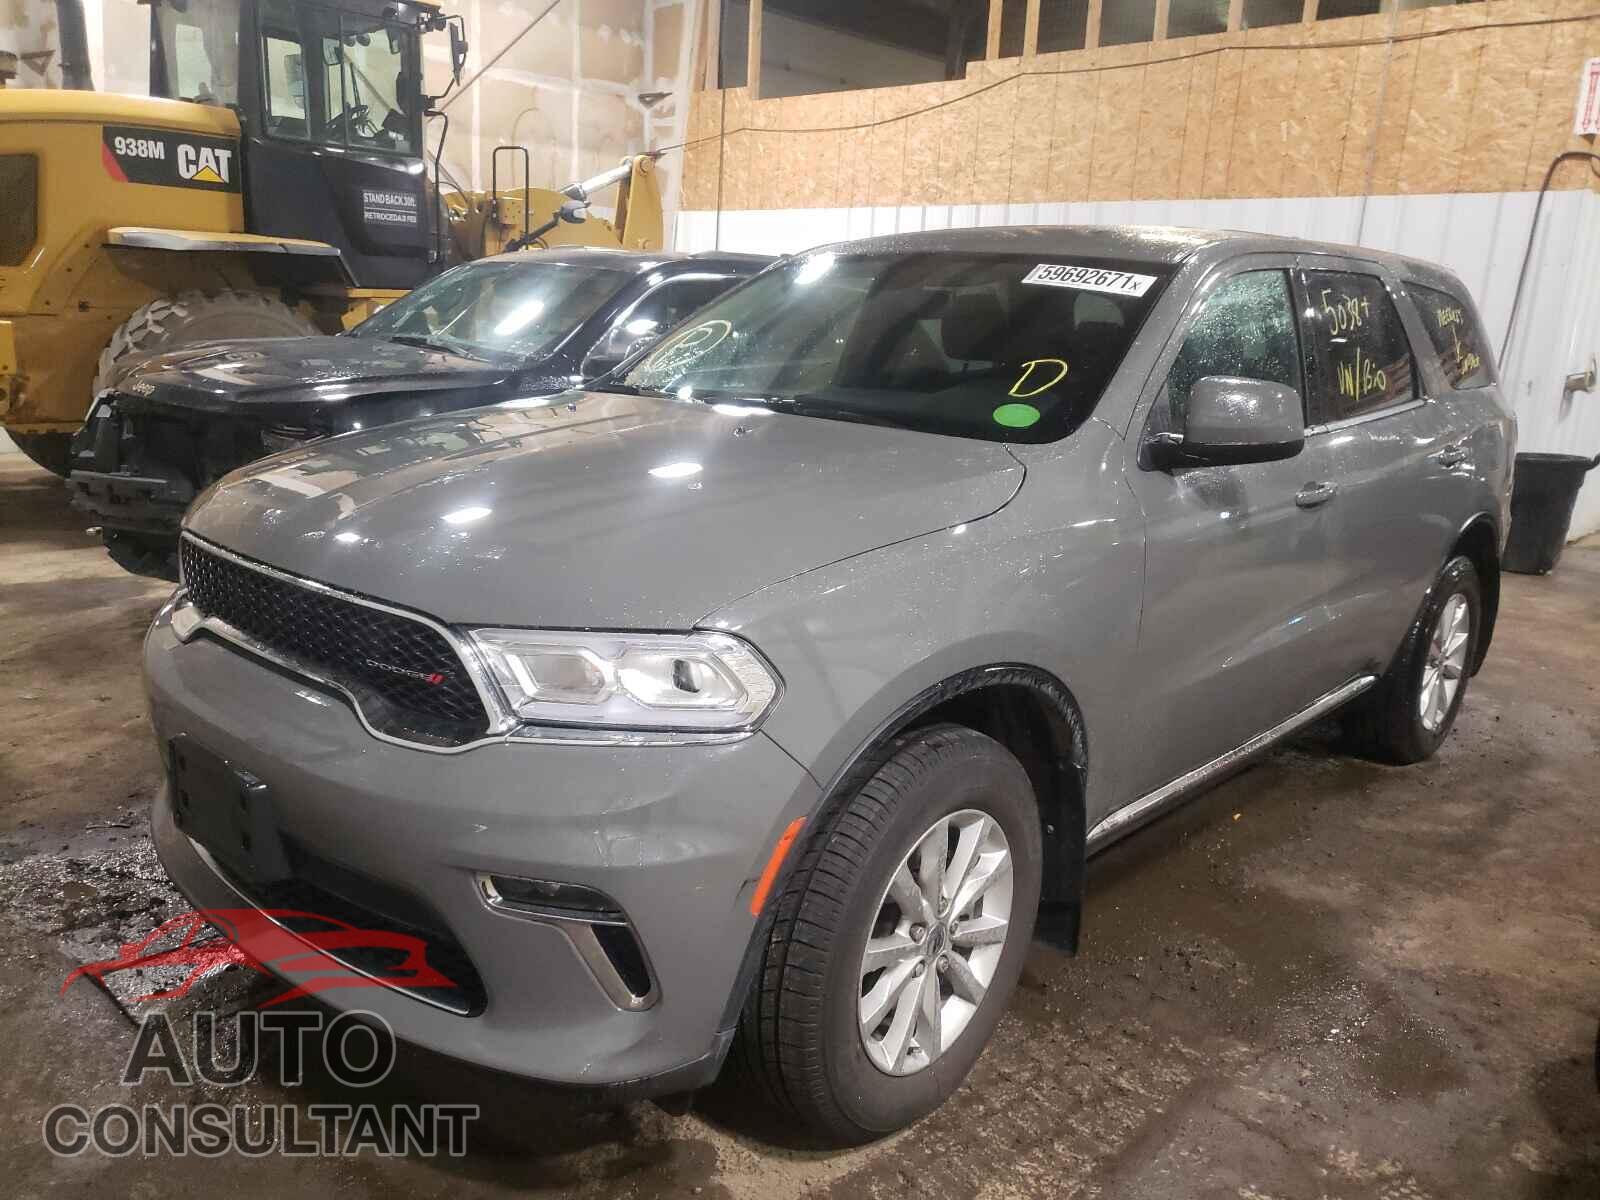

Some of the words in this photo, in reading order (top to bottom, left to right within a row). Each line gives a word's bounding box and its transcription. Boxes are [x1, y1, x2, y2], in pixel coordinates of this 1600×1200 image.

[114, 136, 165, 160] 938M
[176, 143, 232, 184] CAT
[363, 192, 385, 204] STAND
[385, 194, 405, 206] BACK
[1008, 358, 1068, 398] D
